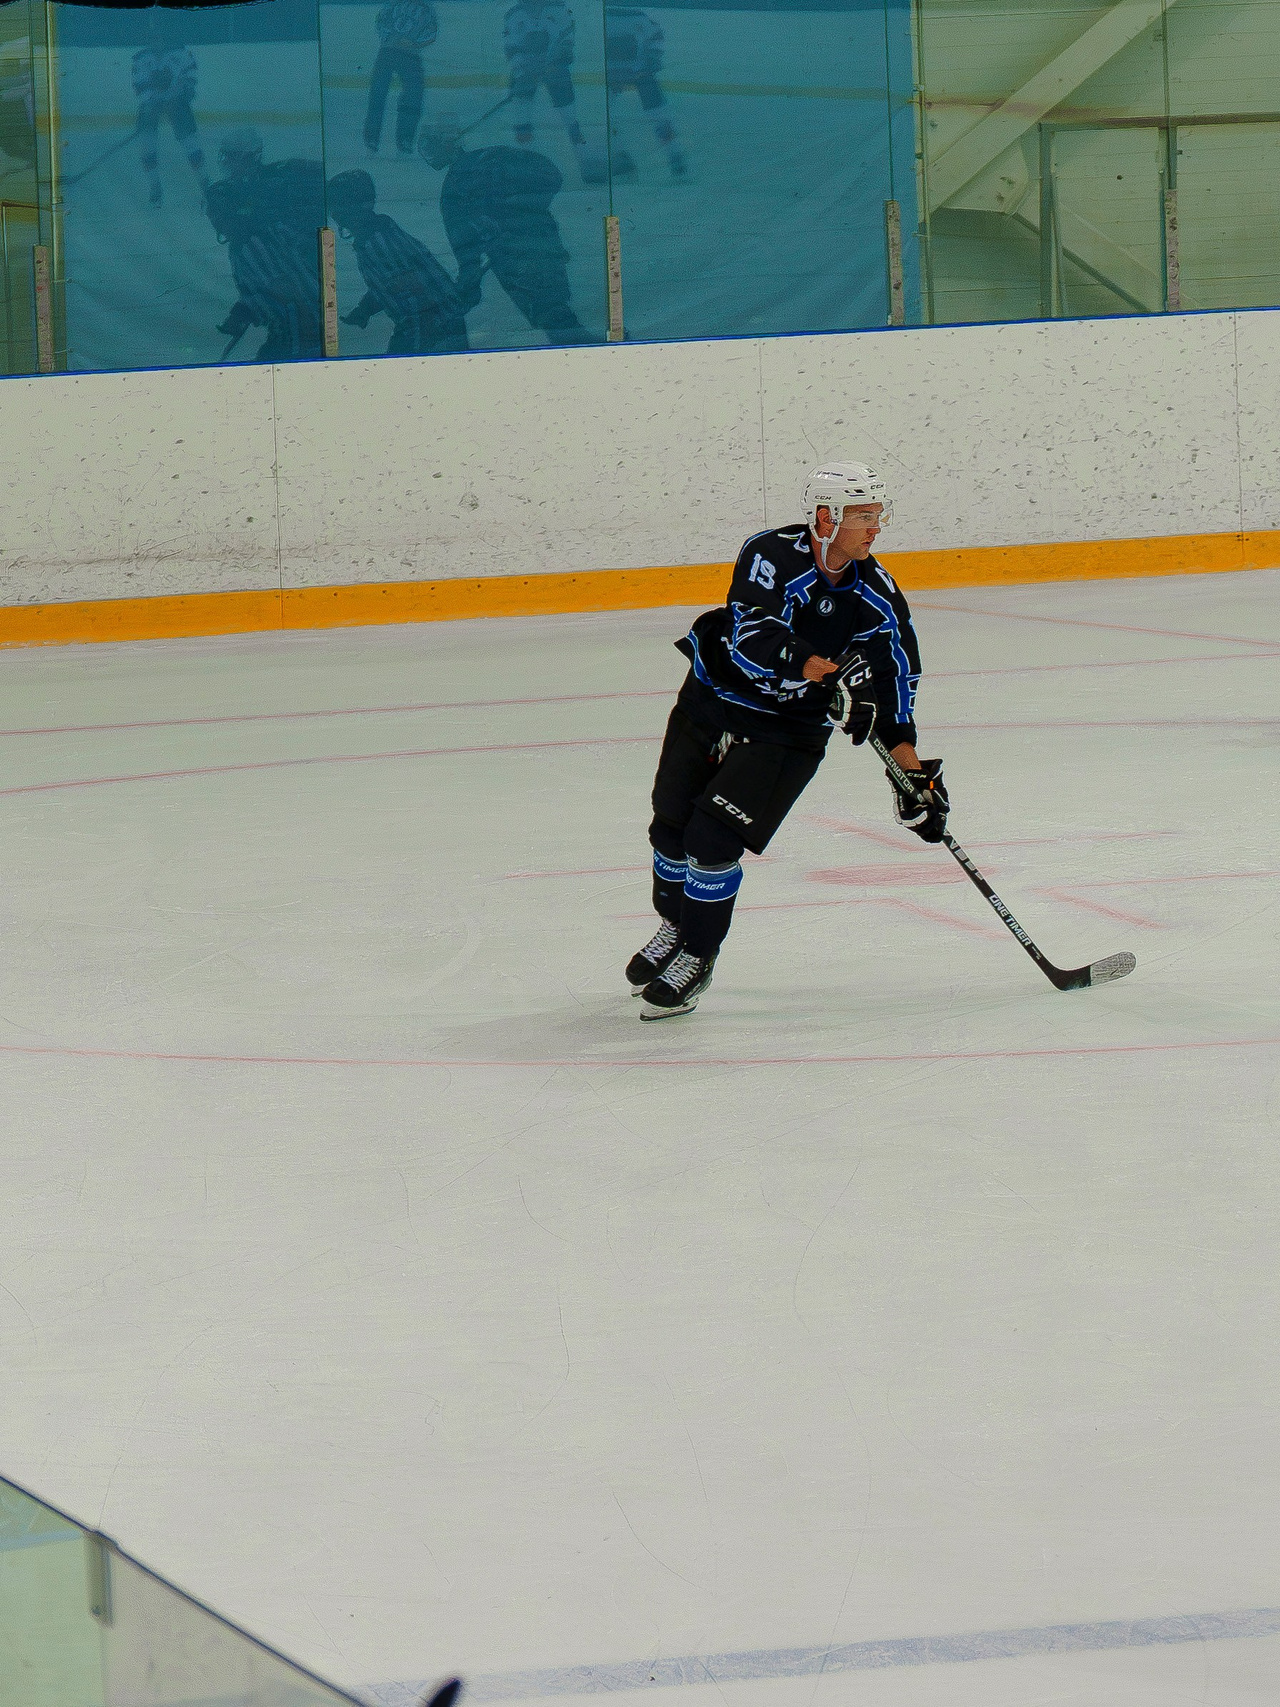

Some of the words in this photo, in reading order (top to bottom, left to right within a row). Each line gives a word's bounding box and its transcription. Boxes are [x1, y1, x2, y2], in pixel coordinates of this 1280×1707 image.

[872, 737, 916, 794] DOMINATOR
[712, 793, 753, 825] CCM
[988, 894, 1010, 918] ONE
[1005, 915, 1032, 947] TIMER
